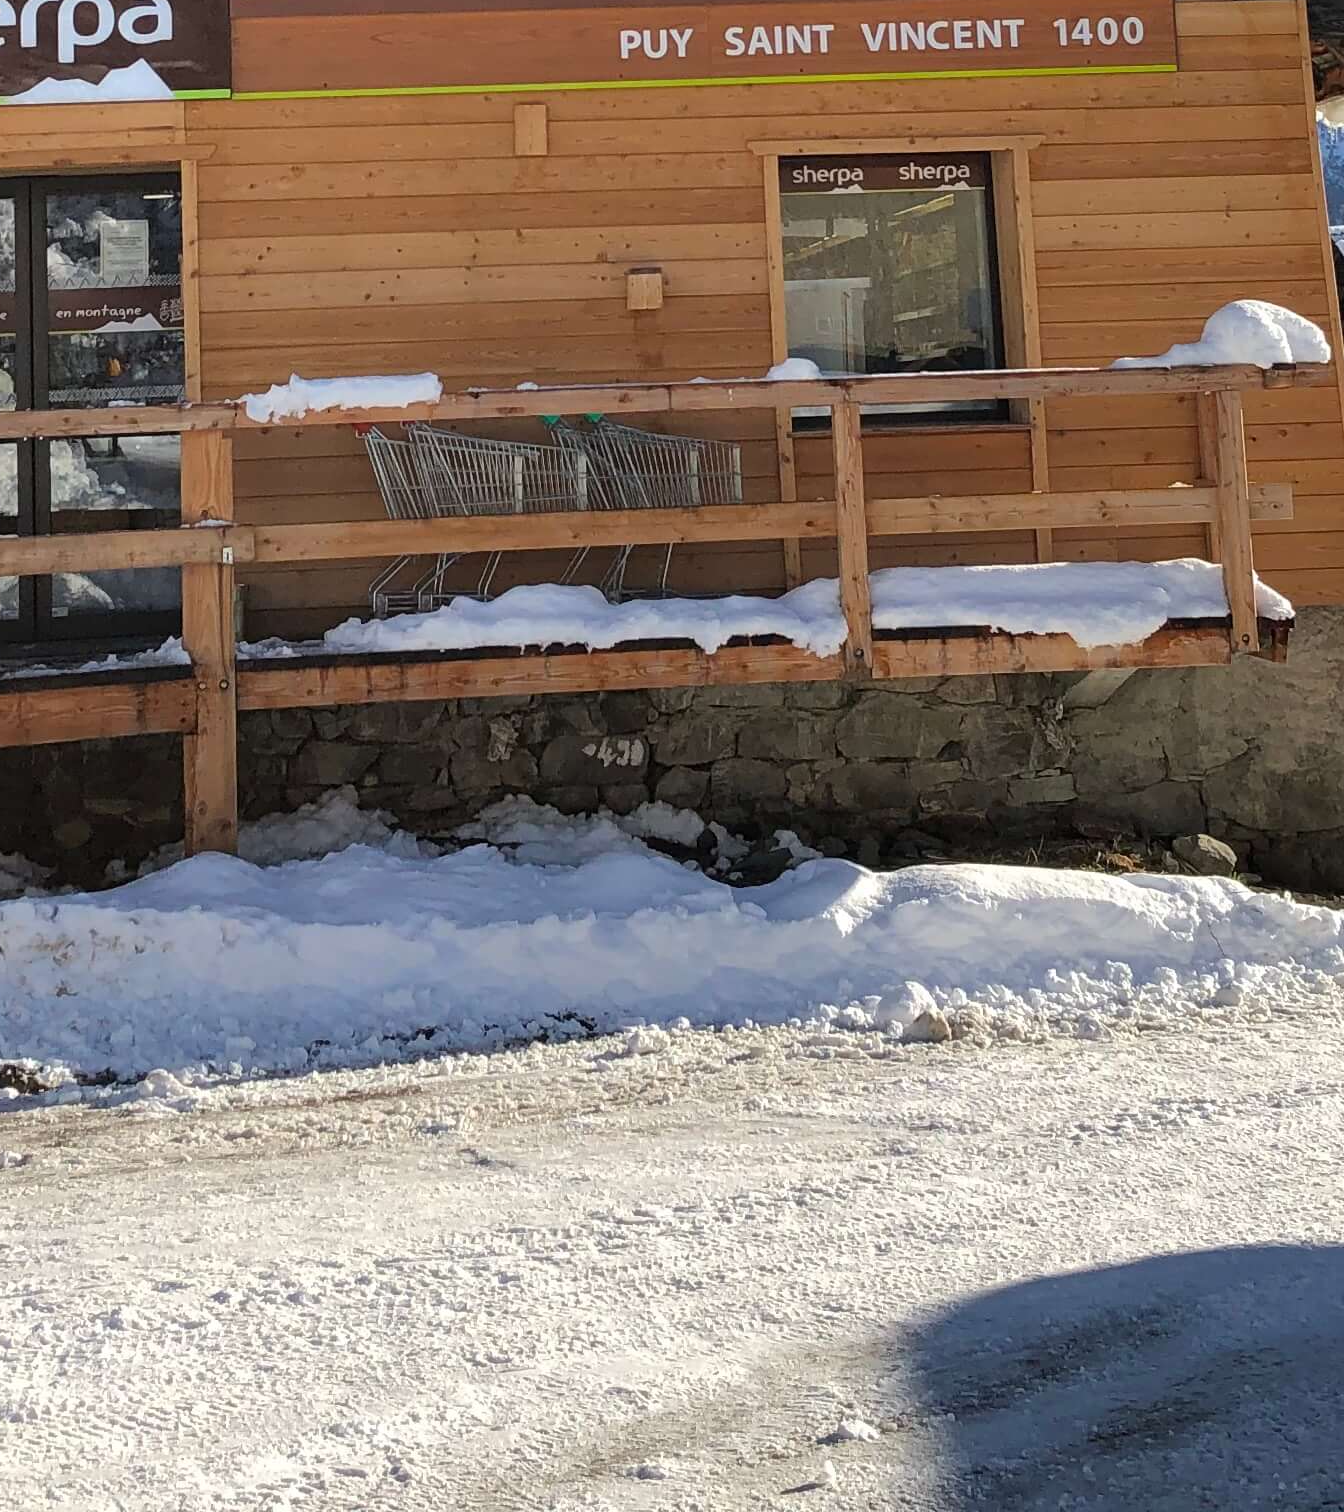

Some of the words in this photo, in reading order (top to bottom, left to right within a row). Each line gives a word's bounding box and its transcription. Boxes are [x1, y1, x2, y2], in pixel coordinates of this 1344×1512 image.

[619, 29, 694, 59] PUY
[724, 25, 835, 56] SAINT
[861, 19, 1025, 52] VINCENT
[1053, 16, 1144, 47] 1400
[792, 165, 864, 185] sherpa
[898, 162, 970, 182] sherpa
[55, 310, 72, 318] en
[75, 304, 142, 322] montagne
